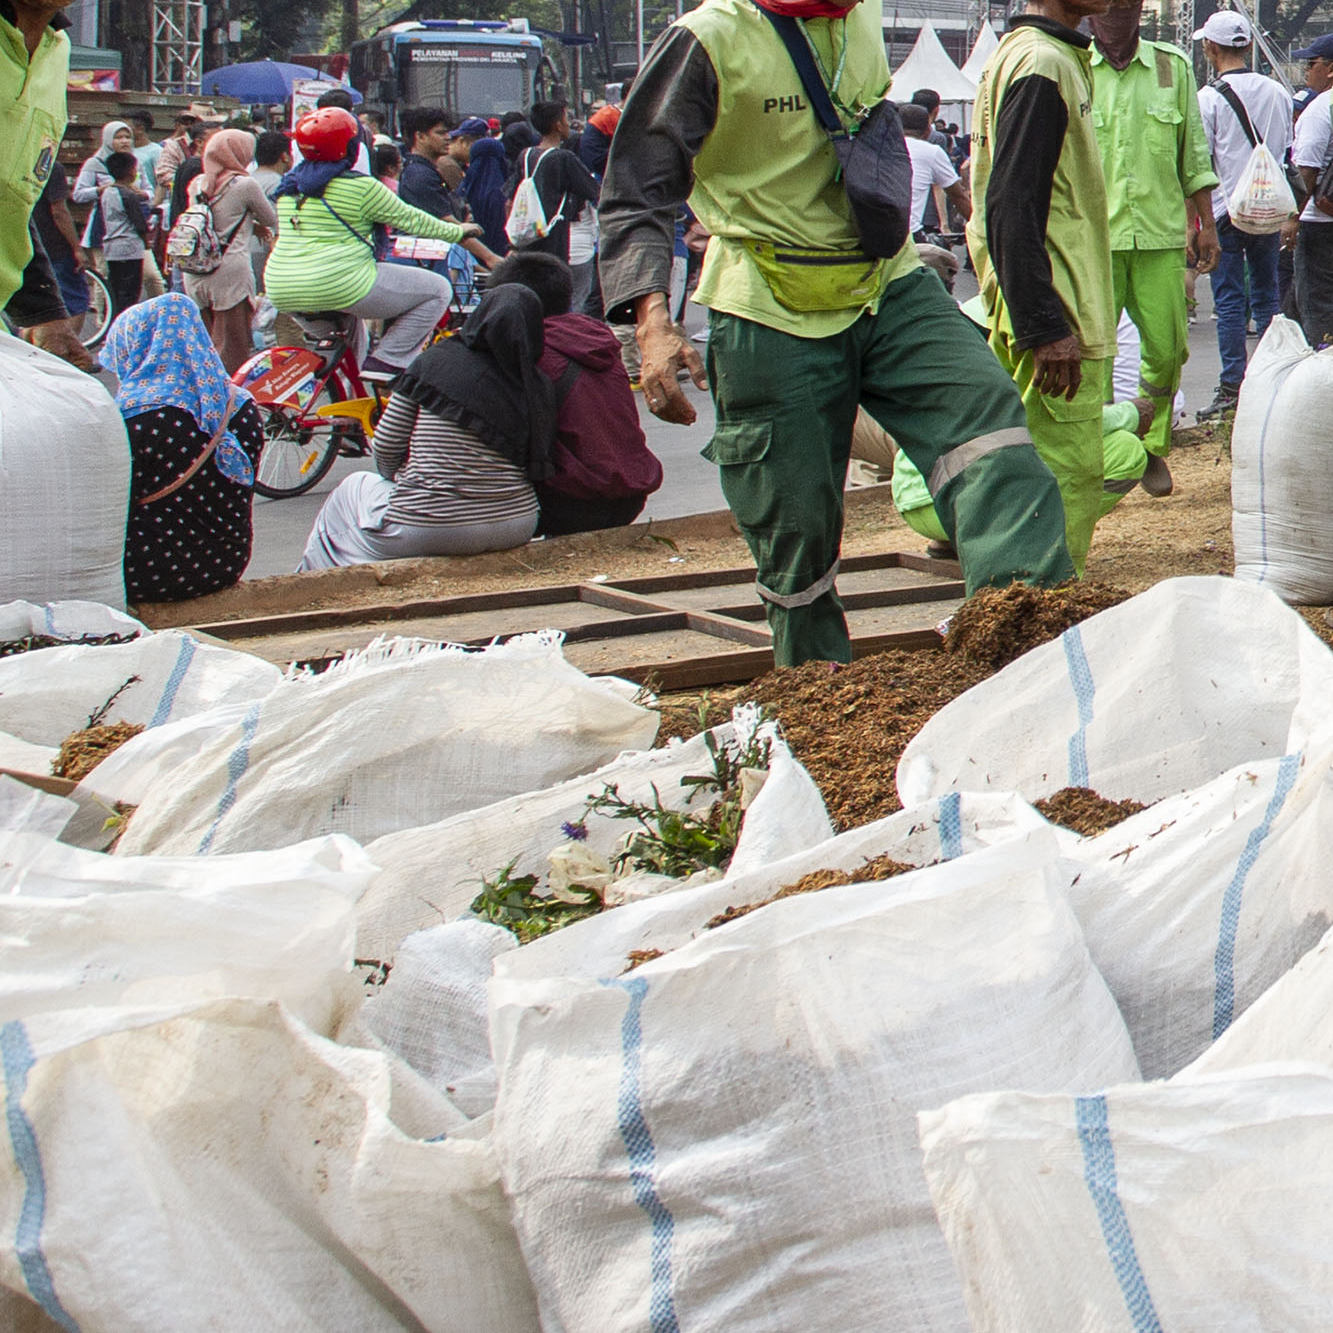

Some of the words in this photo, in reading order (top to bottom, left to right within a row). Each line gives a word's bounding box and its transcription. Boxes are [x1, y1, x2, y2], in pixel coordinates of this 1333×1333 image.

[411, 49, 459, 57] PELAYANAN
[491, 51, 527, 59] KELILING
[763, 94, 807, 113] PHL
